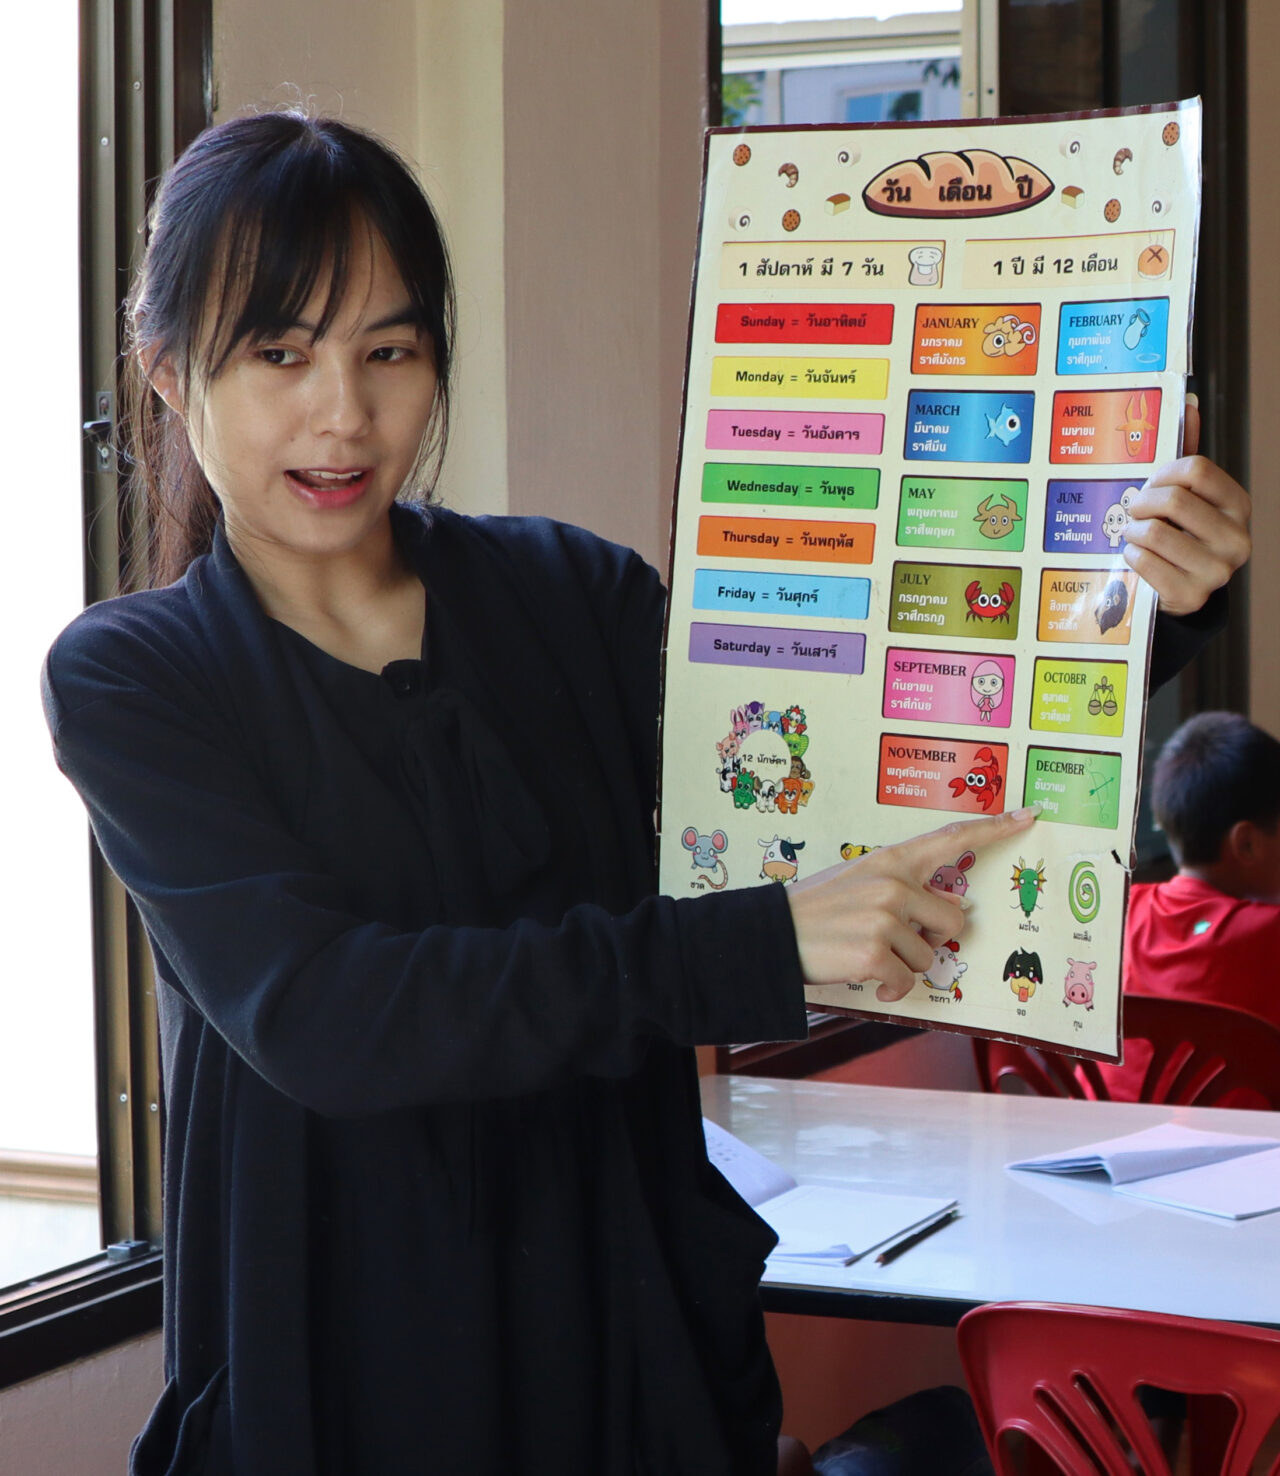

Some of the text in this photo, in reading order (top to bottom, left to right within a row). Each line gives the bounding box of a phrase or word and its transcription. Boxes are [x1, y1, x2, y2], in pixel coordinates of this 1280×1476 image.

[881, 174, 1033, 202] วัน เดือน ปี
[739, 257, 885, 276] 1 สัปดาห์ มี 7 วัน
[993, 252, 1118, 275] 1 ปี มี 12 เดือน
[740, 315, 785, 330] Sunday
[805, 313, 867, 328] วันอาทิตย์
[922, 317, 980, 329] JANUARY
[1069, 314, 1124, 327] FEBRUARY
[921, 337, 963, 348] มกราคม
[919, 354, 966, 366] ราศีมังกร
[735, 370, 784, 385] Monday
[804, 369, 857, 384] วันจันทร์
[915, 404, 960, 416] MARCH
[1062, 405, 1093, 418] APRIL
[731, 425, 781, 441] Tuesday
[802, 425, 860, 441] วันอังคาร
[914, 421, 949, 434] มีนาคม
[1061, 426, 1095, 437] เมษายน
[912, 439, 947, 453] ราศีมีน
[1060, 444, 1094, 456] ราศีเมษ
[727, 480, 799, 496] Wednesday
[820, 481, 855, 501] วันพุธ
[908, 487, 936, 499] MAY
[1056, 492, 1084, 504] JUNE
[906, 507, 959, 519] พฤษภาคม
[722, 530, 779, 547] Thursday
[800, 532, 854, 550] วันพฤหัส
[900, 573, 931, 585] JULY
[1050, 581, 1091, 593] AUGUST
[718, 586, 756, 602] Friday
[776, 587, 820, 608] วันศุกร์
[713, 639, 771, 656] Saturday
[791, 642, 838, 658] วันเสาร์
[893, 660, 967, 677] SEPTEMBER
[1043, 671, 1087, 685] OCTOBER
[892, 678, 934, 693] กันยายน
[890, 696, 933, 712] ราศีกันย์
[742, 753, 787, 765] 12 นักษัตร
[888, 746, 956, 763] NOVEMBER
[886, 766, 941, 780] พฤศจิกายน
[1036, 760, 1085, 776] DECEMBER
[885, 783, 927, 798] ราศีพิจิก
[846, 983, 864, 992] วอก
[929, 994, 950, 1004] ระกา
[1016, 1008, 1027, 1017] จอ
